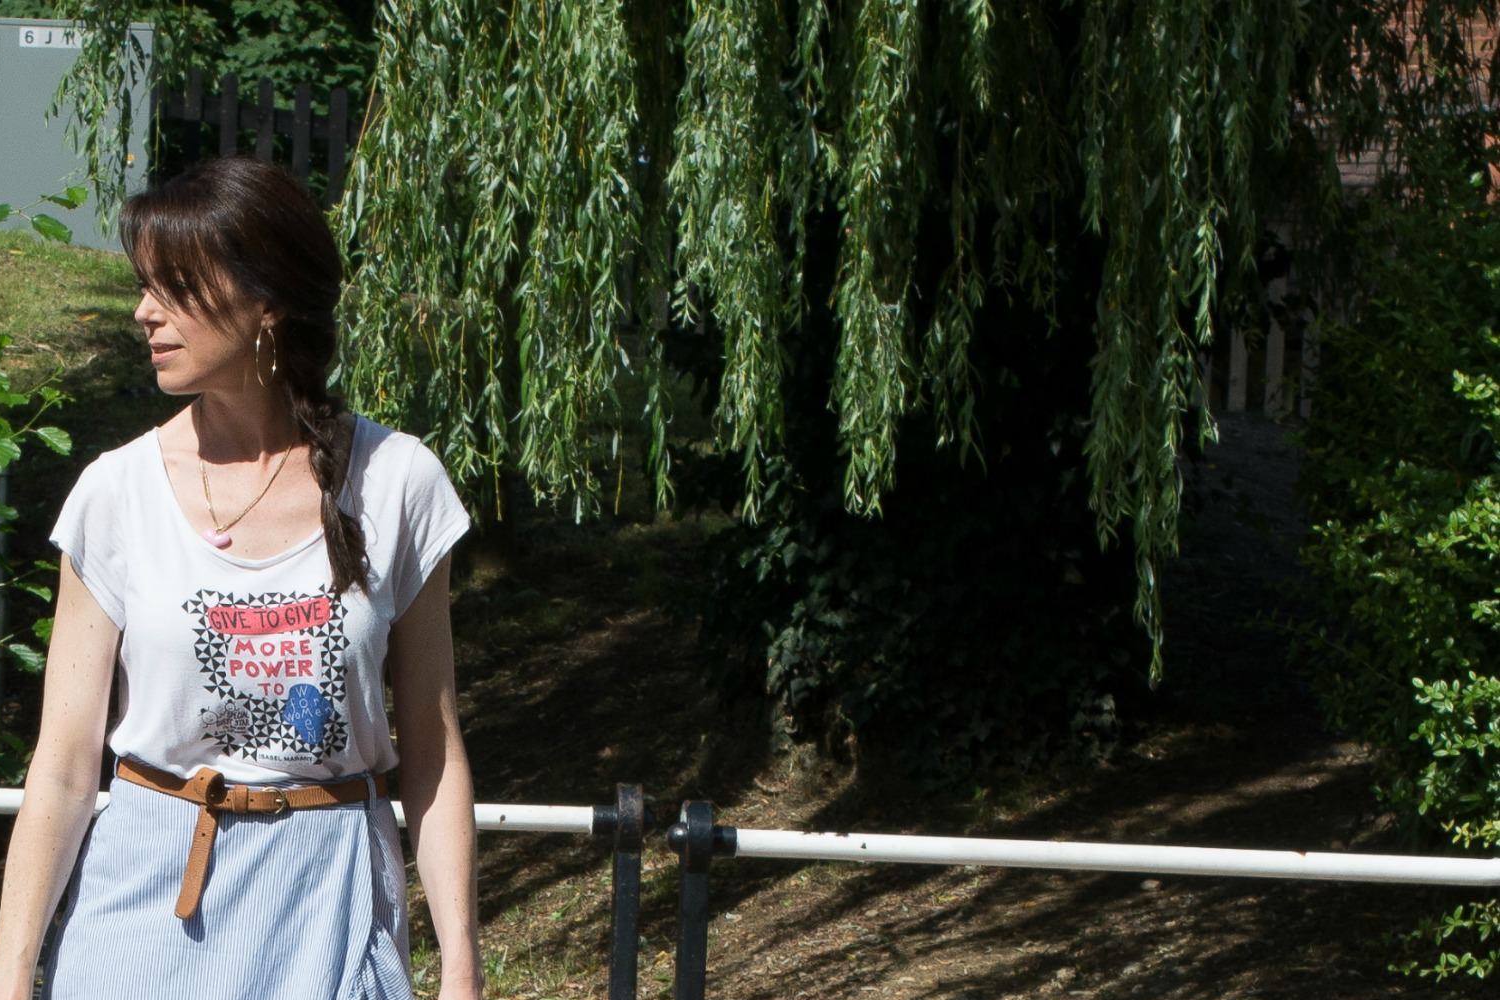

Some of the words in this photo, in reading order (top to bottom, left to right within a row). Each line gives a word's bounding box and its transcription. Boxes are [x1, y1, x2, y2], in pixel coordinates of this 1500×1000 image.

[25, 30, 34, 45] 6
[45, 31, 52, 45] J
[210, 610, 250, 630] GIVE
[254, 610, 279, 628] TO
[284, 601, 325, 626] GIVE
[234, 639, 312, 656] MORE
[229, 660, 314, 678] POWER
[257, 683, 284, 696] TO
